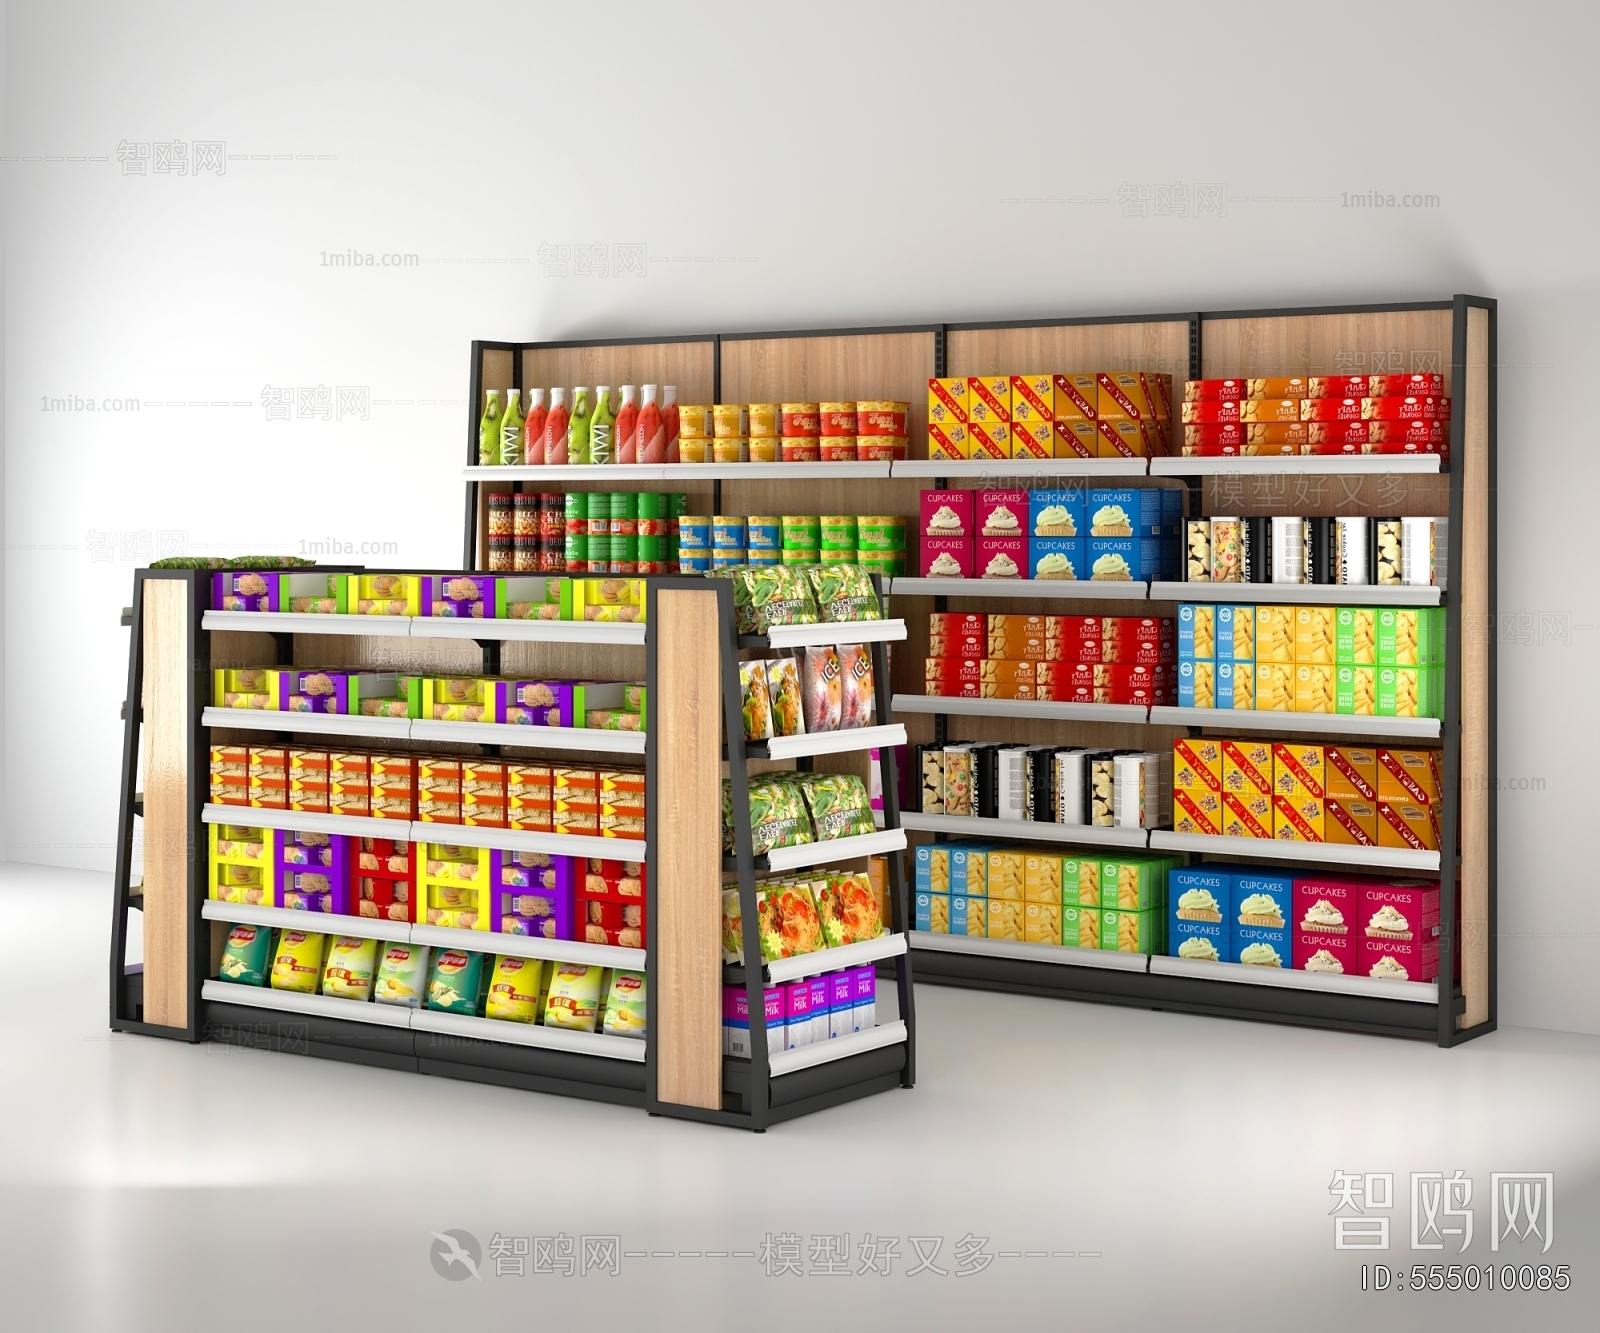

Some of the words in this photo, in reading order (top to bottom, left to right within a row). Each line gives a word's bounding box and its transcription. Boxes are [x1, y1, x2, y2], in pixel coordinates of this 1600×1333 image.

[504, 427, 519, 465] KIWI
[593, 425, 609, 464] KIWI
[928, 494, 963, 502] CUPCAKES
[983, 494, 1020, 502] CUPCAKES
[1037, 494, 1075, 502] CUPCAKES
[1093, 494, 1131, 502] CUPCAKES
[928, 541, 963, 549] CUPCAKES
[983, 541, 1020, 549] CUPCAKES
[1037, 542, 1075, 550] CUPCAKES
[1093, 542, 1131, 550] CUPCAKES
[821, 657, 840, 683] ICE
[851, 657, 870, 681] ICE
[1178, 876, 1220, 886] CUPCAKES
[1240, 880, 1283, 892] CUPCAKES
[1302, 886, 1347, 898] CUPCAKES
[1366, 891, 1412, 903] CUPCAKES
[1178, 924, 1220, 936] CUPCAKES
[1240, 929, 1283, 941] CUPCAKES
[1302, 936, 1347, 947] CUPCAKES
[1366, 941, 1412, 954] CUPCAKES
[836, 989, 848, 999] Milk
[859, 984, 871, 994] Milk
[794, 1001, 807, 1010] Milk
[812, 996, 824, 1005] Milk
[765, 1006, 779, 1016] Milk
